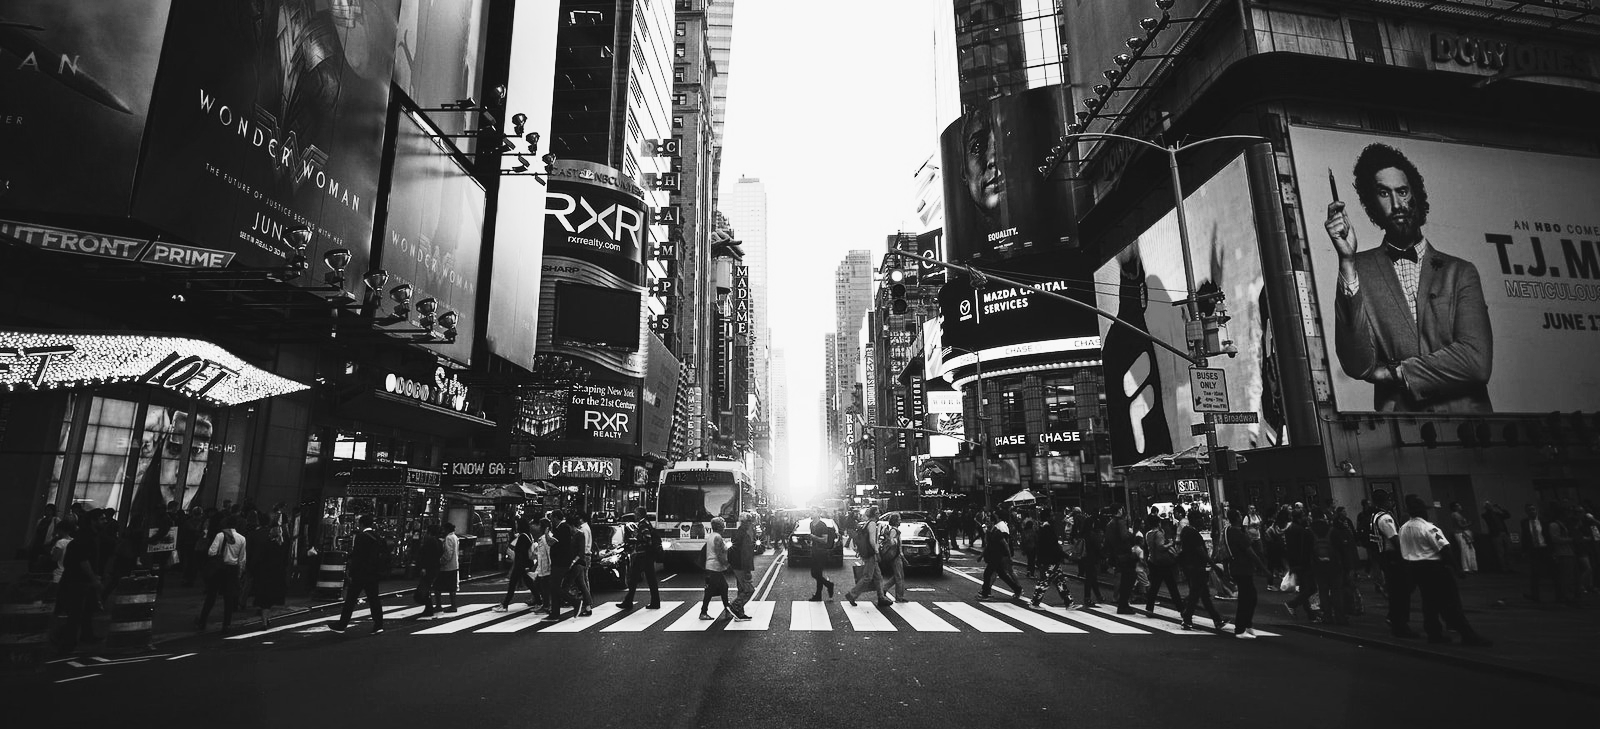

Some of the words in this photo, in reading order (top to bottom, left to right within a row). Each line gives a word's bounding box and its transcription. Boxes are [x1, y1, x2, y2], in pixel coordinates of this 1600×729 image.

[200, 89, 293, 167] WONDER
[302, 160, 360, 212] WOMAN
[206, 162, 220, 177] THE
[223, 173, 251, 195] FUTURE
[253, 190, 264, 200] OF
[265, 198, 292, 217] JUSTICE
[252, 212, 288, 241] JUN
[545, 192, 641, 249] RXR
[1514, 220, 1530, 231] AN
[1534, 222, 1561, 232] HBO
[567, 235, 621, 252] rxrrealty.com
[154, 245, 225, 268] PRIME
[392, 230, 437, 273] WONDER
[442, 266, 474, 295] WOMAN
[1485, 233, 1561, 277] T.J.
[543, 265, 580, 274] SHARP
[736, 266, 747, 333] MADAME
[983, 287, 1017, 303] MAZDA
[984, 298, 1029, 315] SERVICES
[1542, 312, 1586, 331] JUNE
[1005, 345, 1033, 355] CHASE
[1196, 372, 1218, 380] BUSES
[607, 386, 622, 395] New
[623, 388, 635, 398] York
[1200, 381, 1216, 389] ONLY
[572, 394, 585, 405] for
[587, 395, 600, 405] the
[600, 397, 614, 407] 21st
[615, 399, 637, 413] Century
[912, 377, 922, 415] VICTORY
[584, 410, 629, 432] RXR
[1223, 413, 1257, 424] Broadway
[593, 430, 622, 439] REALTY
[846, 413, 855, 466] REGAL
[994, 434, 1026, 446] CHASE
[1039, 431, 1081, 443] CHASE
[452, 462, 485, 475] KNOW
[488, 462, 517, 475] GAE
[548, 460, 613, 477] CHAMPS
[1178, 480, 1200, 491] SODA
